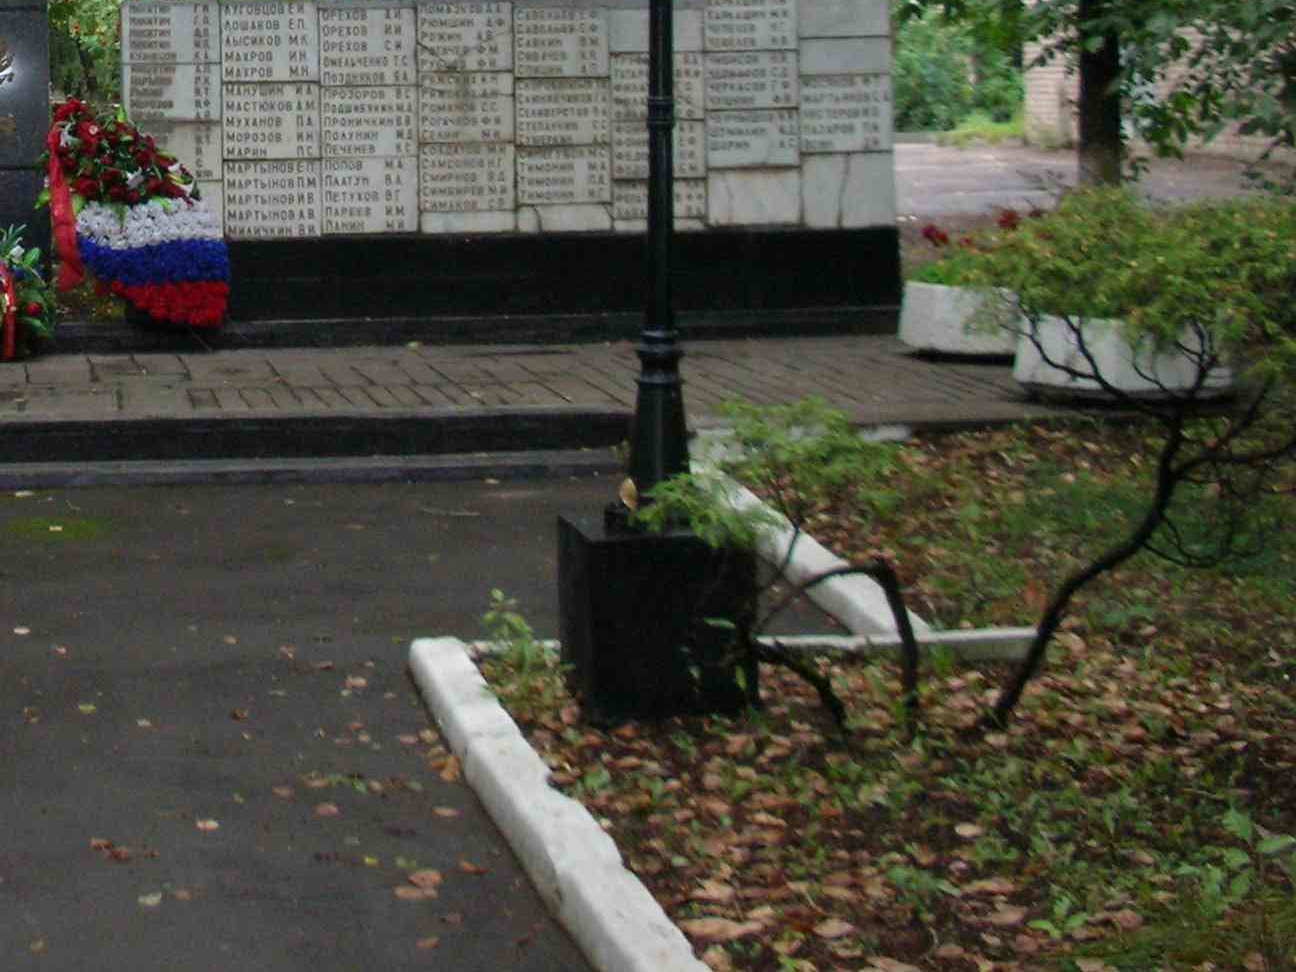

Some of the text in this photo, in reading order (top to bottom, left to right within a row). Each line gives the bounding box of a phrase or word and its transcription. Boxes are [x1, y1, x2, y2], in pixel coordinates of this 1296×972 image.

[322, 10, 368, 21] ОРЕХОВ
[322, 25, 368, 37] ОРЕХОВ
[224, 35, 282, 47] ЛЫСИКОВ
[322, 41, 369, 53] ОРЕХОВ
[224, 51, 274, 63] МАХРОВ
[224, 67, 274, 78] МАХРОВ
[225, 100, 293, 112] МАСТЮКОВ
[225, 116, 283, 128] МУХАНОВ
[225, 132, 283, 143] МОРОЗОВ
[226, 162, 294, 174] МАРТЫНОВ
[226, 178, 295, 190] МАРТЫНОВ
[227, 193, 295, 205] МАРТЫНОВ
[227, 209, 296, 221] МАРТЫНОВ
